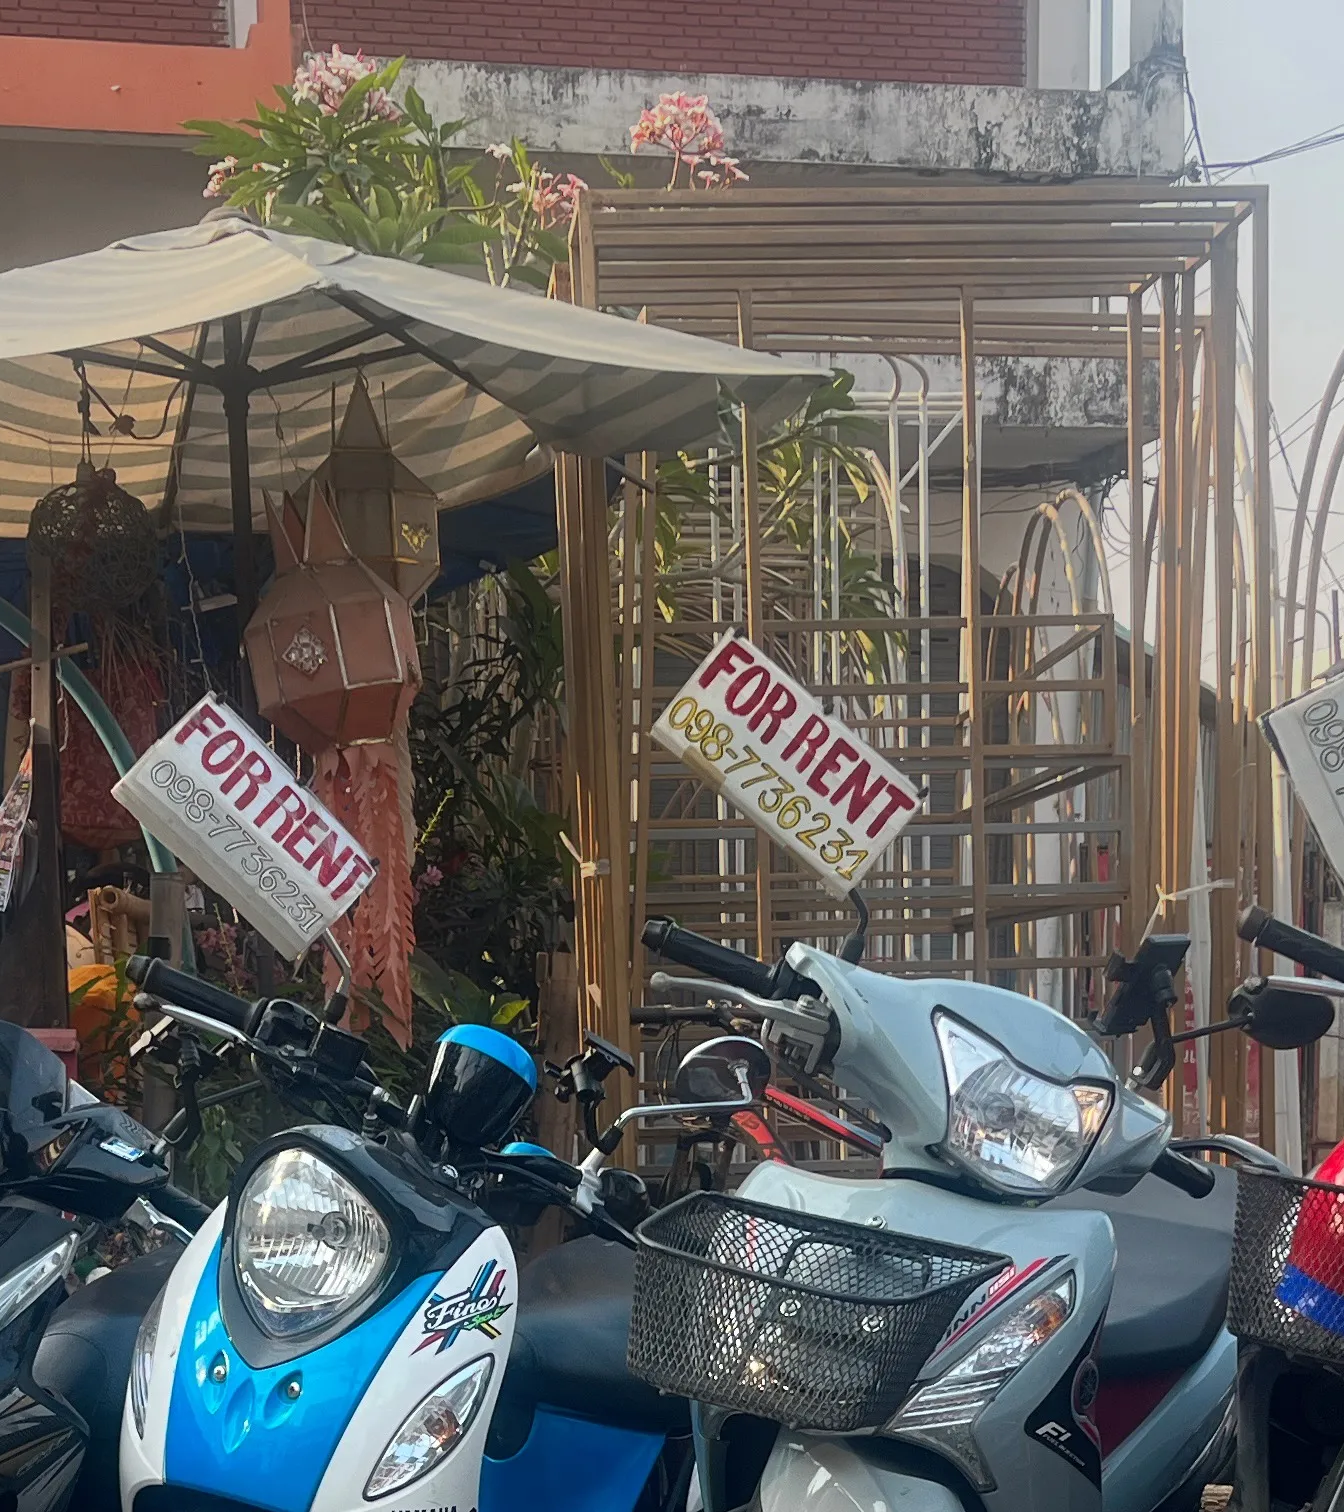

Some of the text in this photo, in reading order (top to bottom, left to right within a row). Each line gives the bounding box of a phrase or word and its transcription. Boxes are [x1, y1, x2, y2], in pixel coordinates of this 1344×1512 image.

[174, 703, 373, 901] FOR RENT
[668, 696, 869, 881] 098-7736231
[698, 640, 916, 839] FOR RENT
[151, 760, 323, 934] 098-7736231
[427, 1292, 497, 1331] Fino
